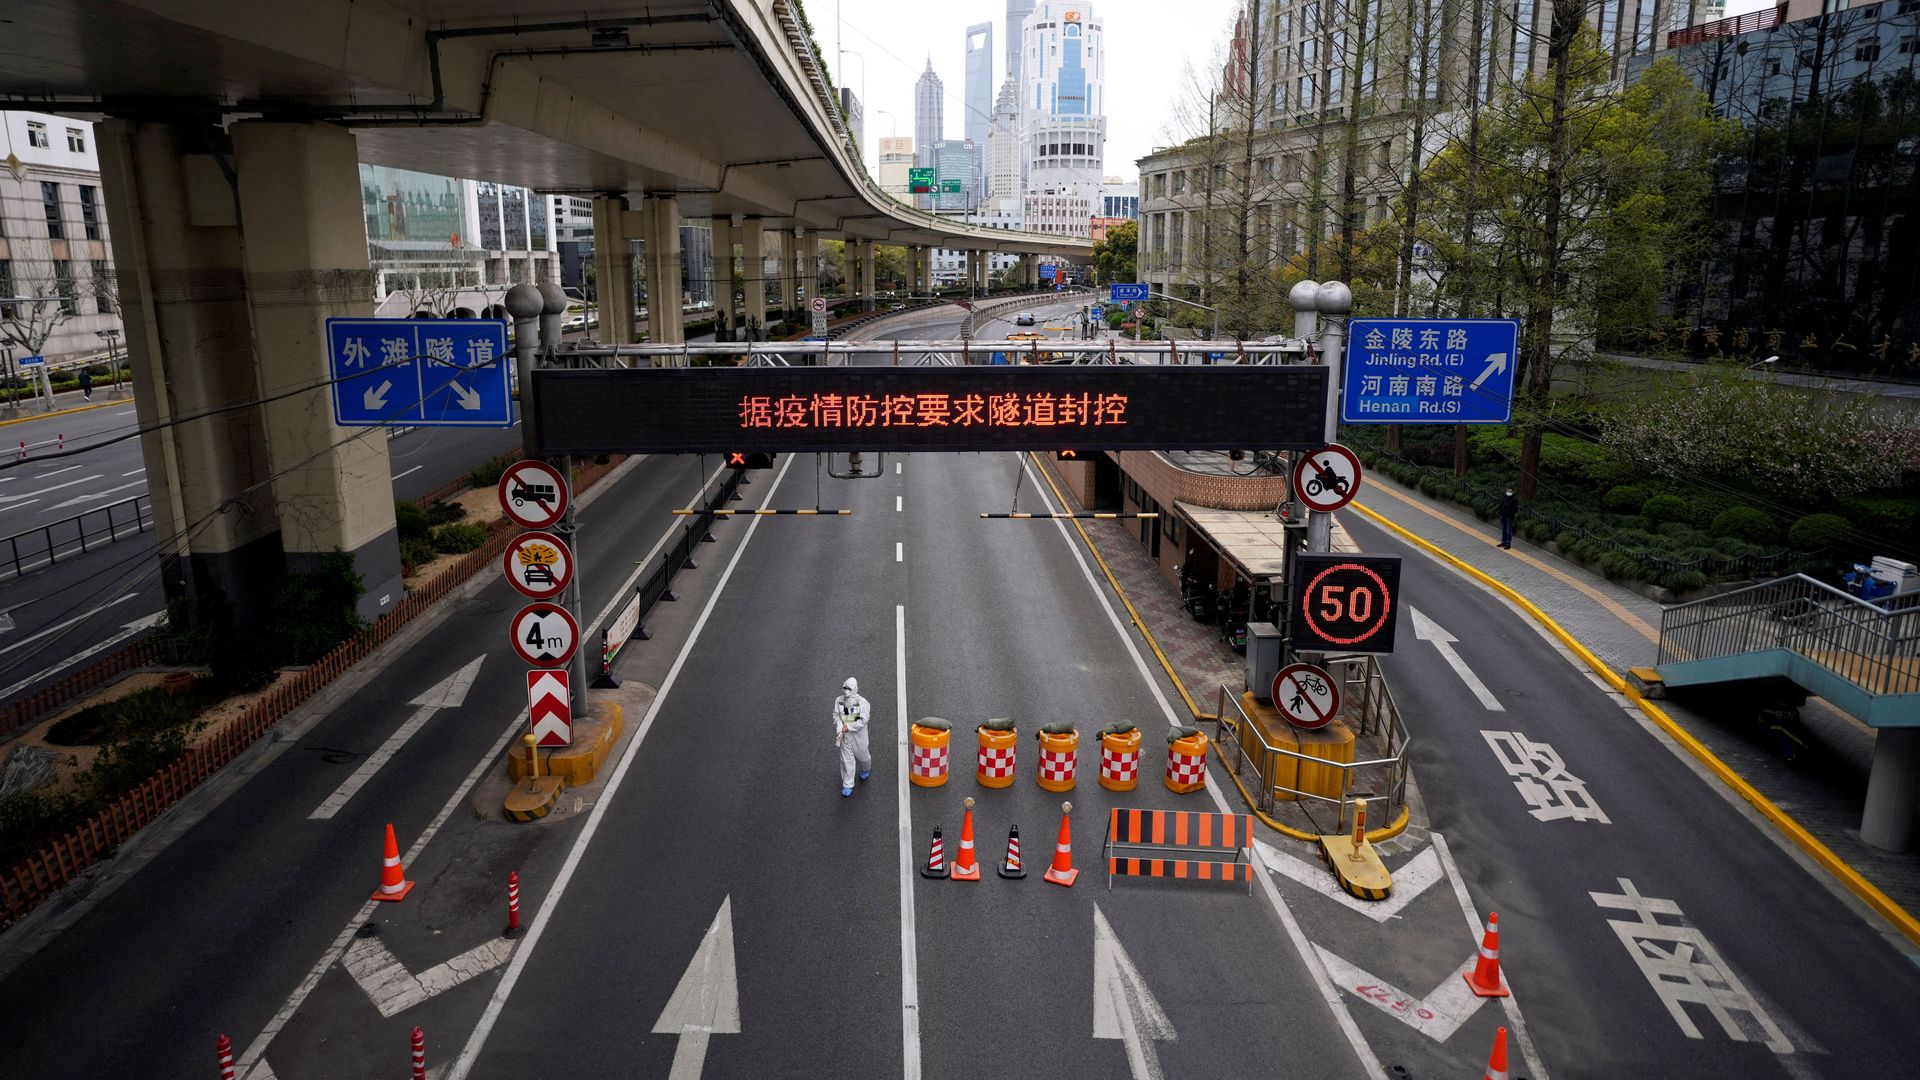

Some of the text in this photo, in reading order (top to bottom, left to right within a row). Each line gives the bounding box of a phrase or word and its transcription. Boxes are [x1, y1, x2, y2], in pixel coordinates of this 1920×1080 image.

[1364, 328, 1468, 351] 金陵东路
[342, 337, 497, 369] 外滩隧道
[1365, 353, 1416, 368] Jinling
[1361, 374, 1464, 397] 河南南路
[738, 392, 1129, 428] 据疫情防控要求隧道封控
[1359, 400, 1411, 413] Henan
[1320, 585, 1373, 623] 50
